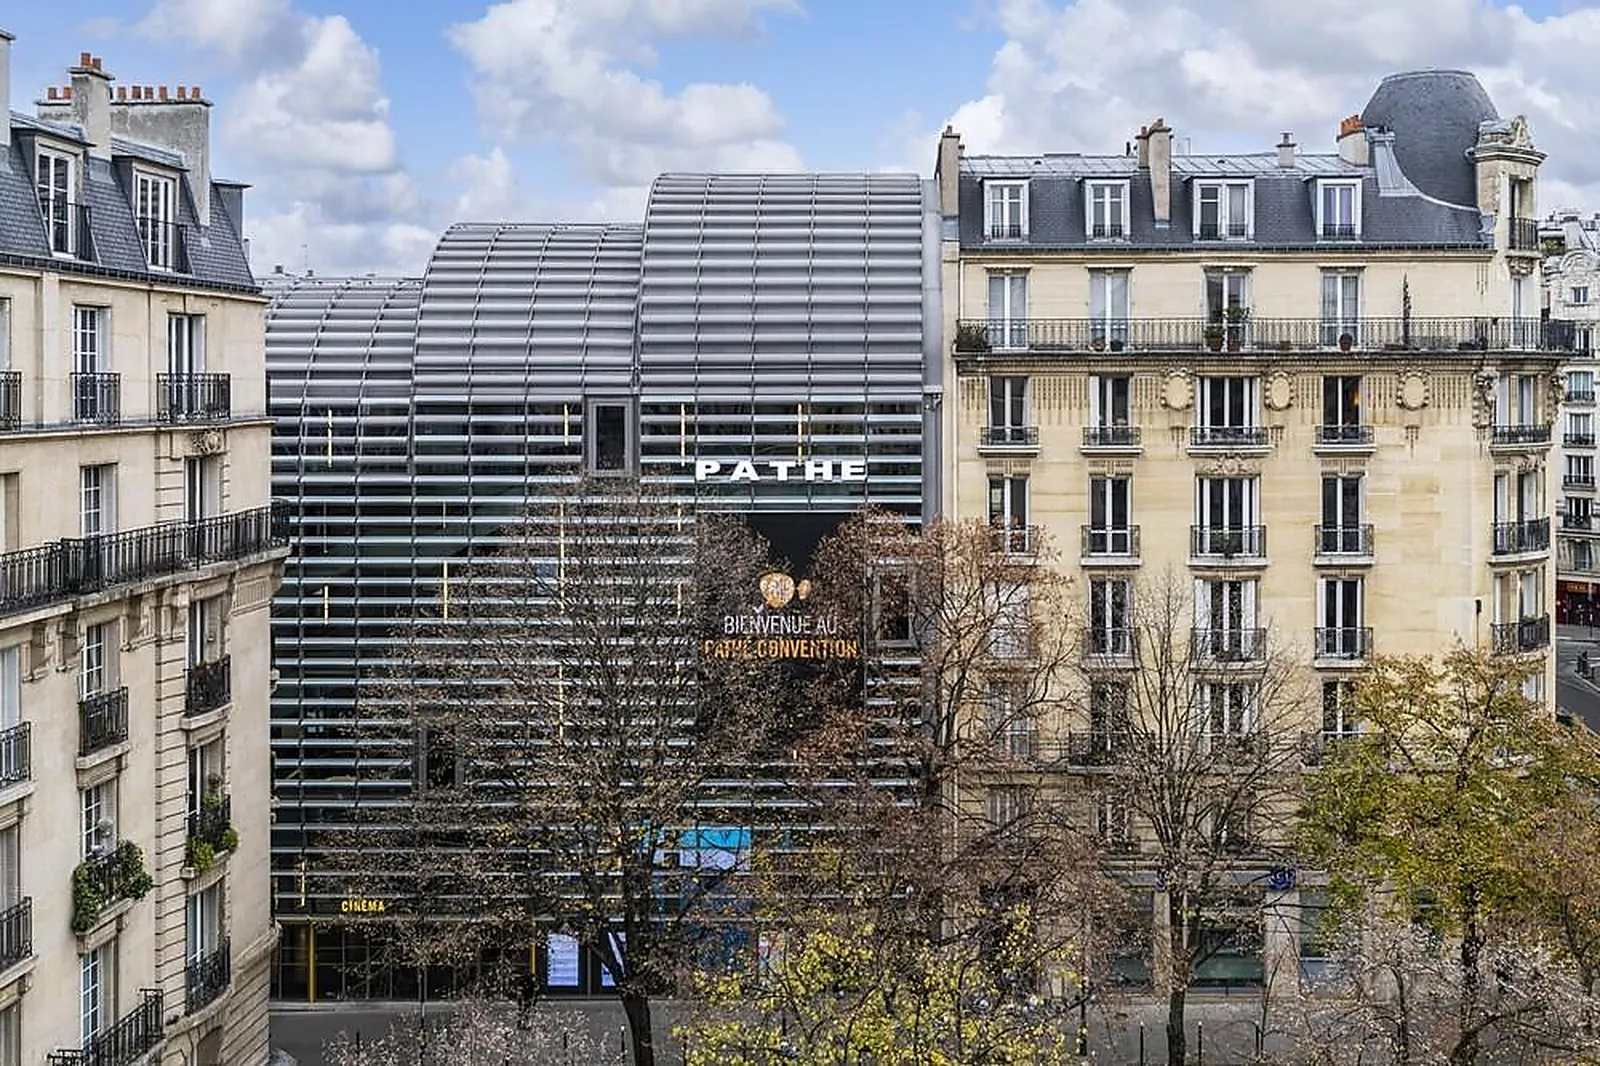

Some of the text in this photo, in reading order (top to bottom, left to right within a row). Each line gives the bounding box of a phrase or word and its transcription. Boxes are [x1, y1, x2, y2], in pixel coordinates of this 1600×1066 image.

[695, 459, 867, 481] PATHE
[724, 615, 838, 634] BIENVENUE AU
[757, 639, 858, 659] CONVENTION
